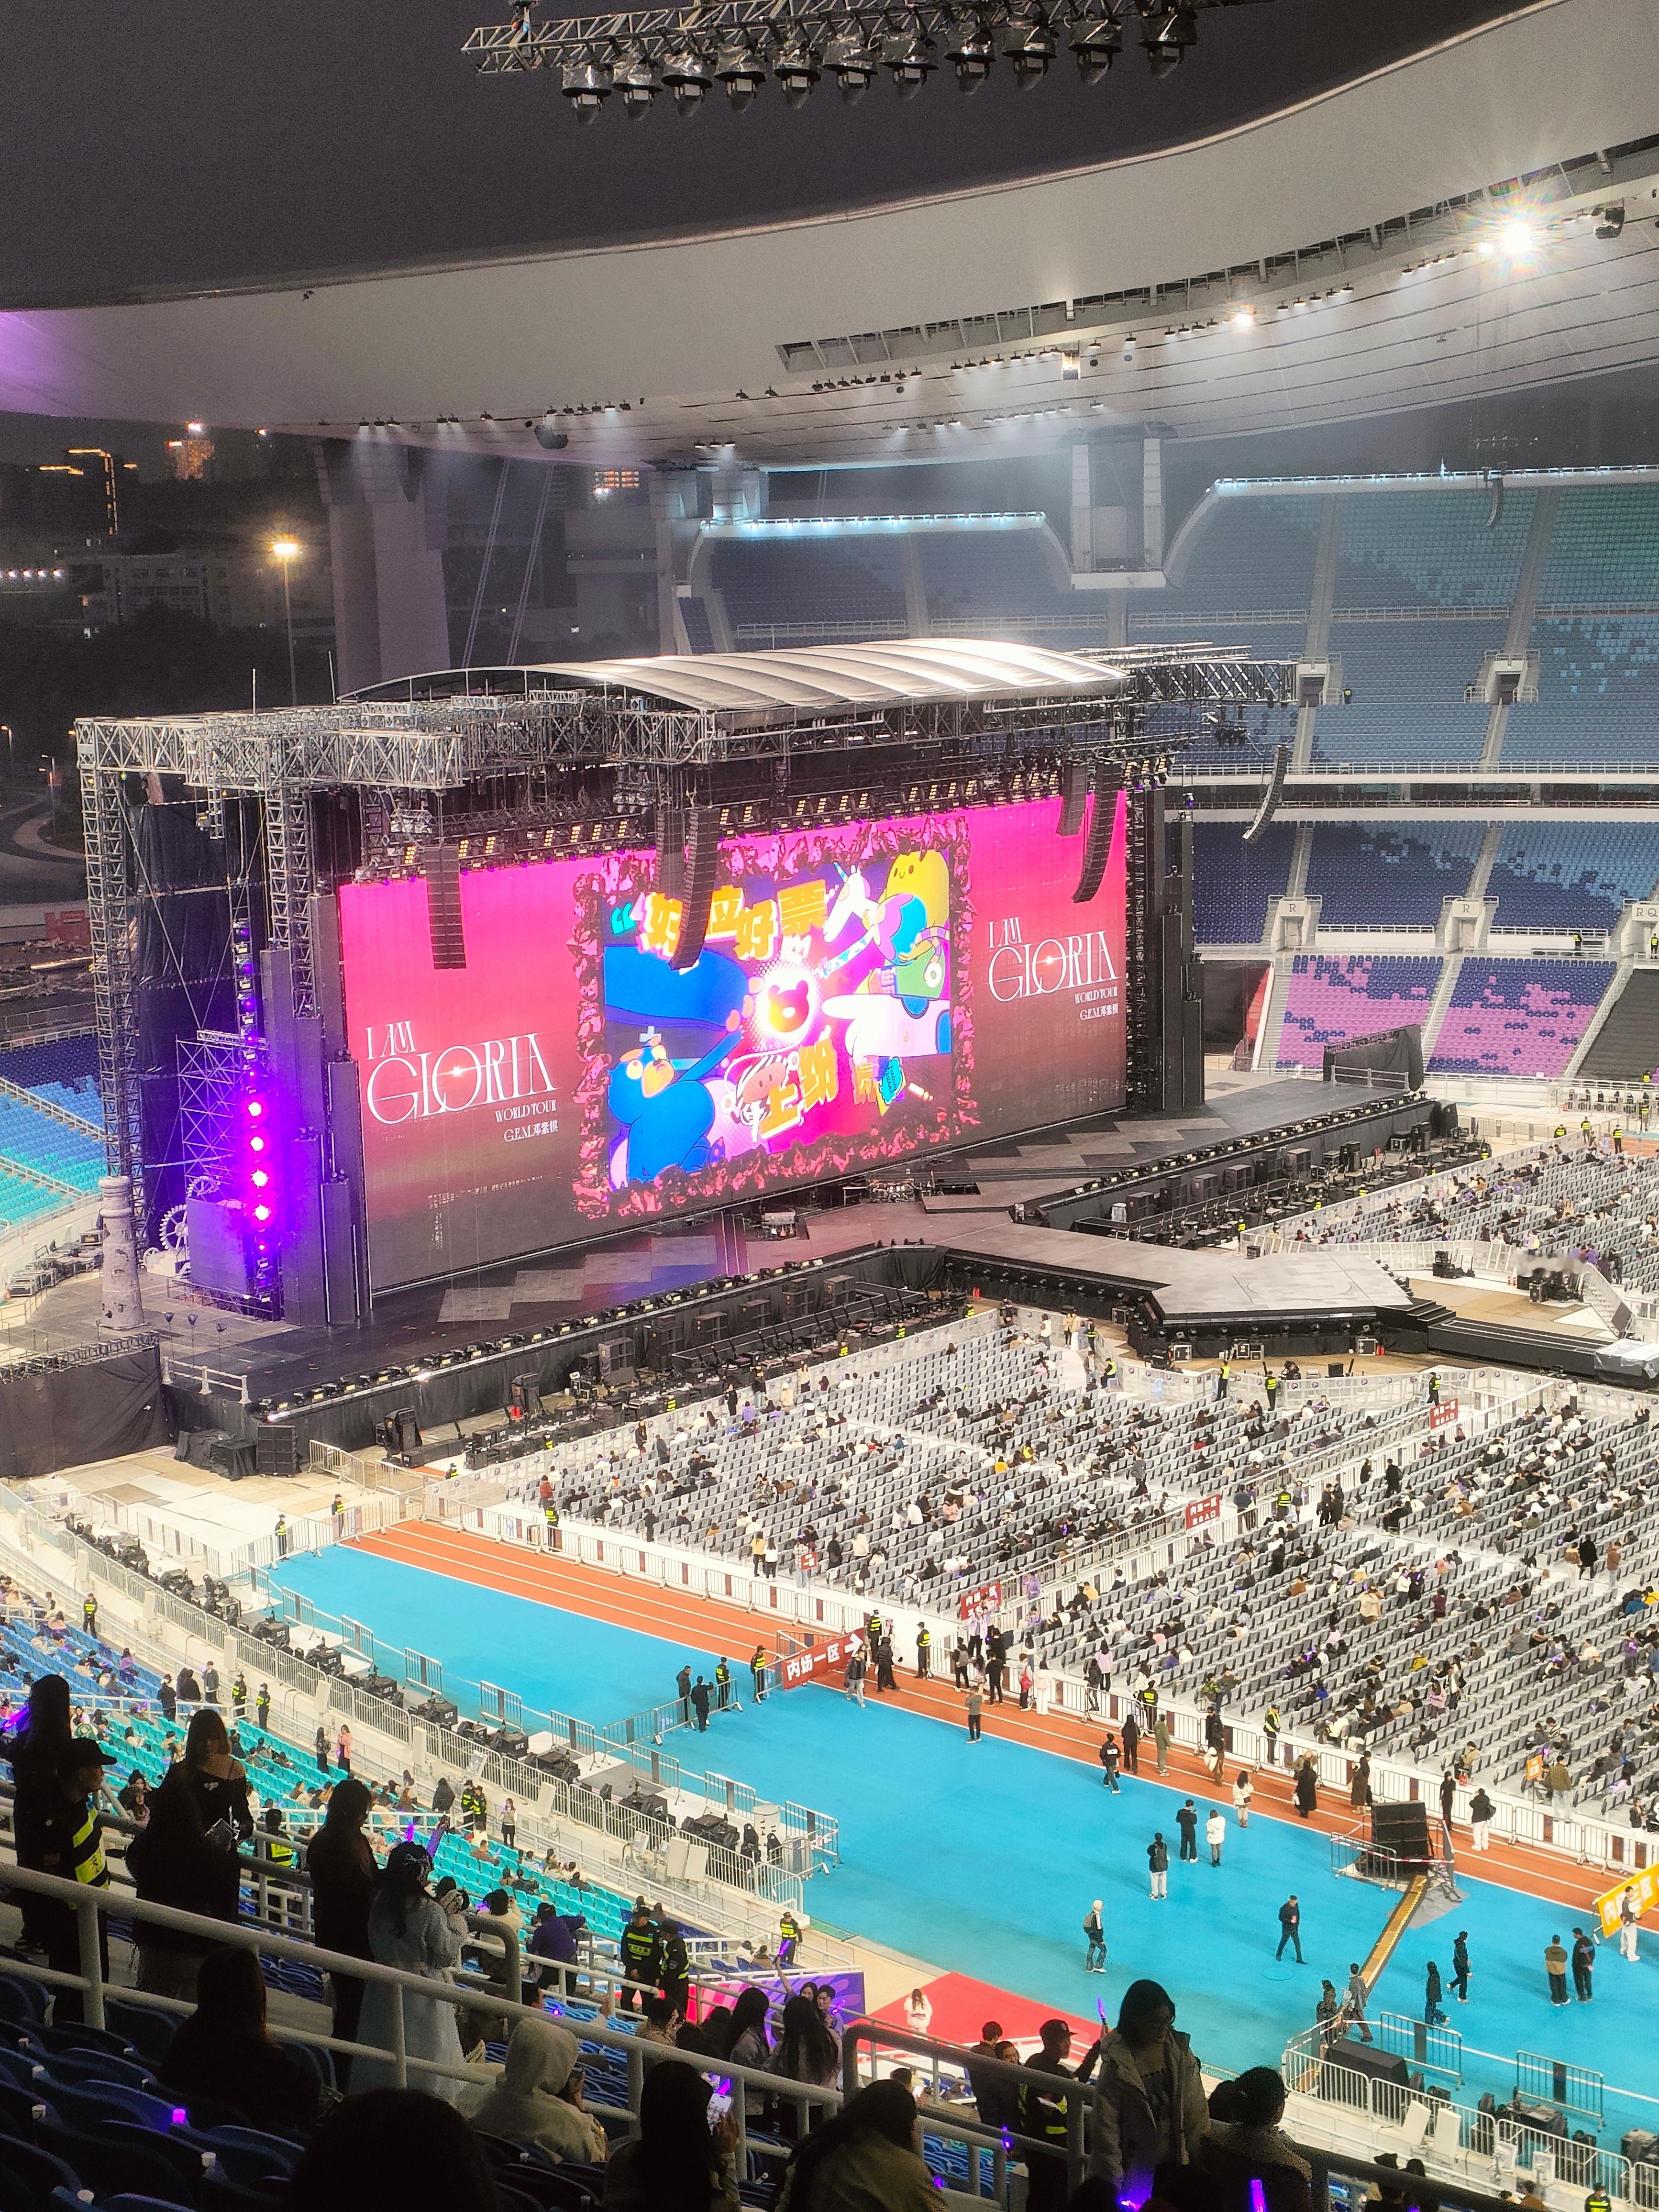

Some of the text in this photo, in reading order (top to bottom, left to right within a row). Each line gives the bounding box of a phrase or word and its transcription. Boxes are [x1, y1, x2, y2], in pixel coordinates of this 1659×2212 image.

[1289, 903, 1296, 912] R
[1462, 904, 1470, 913] R
[1636, 907, 1658, 917] R Q
[988, 917, 1022, 949] I AM
[988, 930, 1118, 1002] GLORIA
[1074, 986, 1118, 1004] WORLD TOUR
[365, 1020, 417, 1061] I AM
[367, 1033, 558, 1124] GLORIA
[495, 1099, 557, 1123] WORLD TOUR
[786, 1643, 841, 1681] 内场一区
[444, 1711, 453, 1719] SFX
[515, 1742, 525, 1750] SFX
